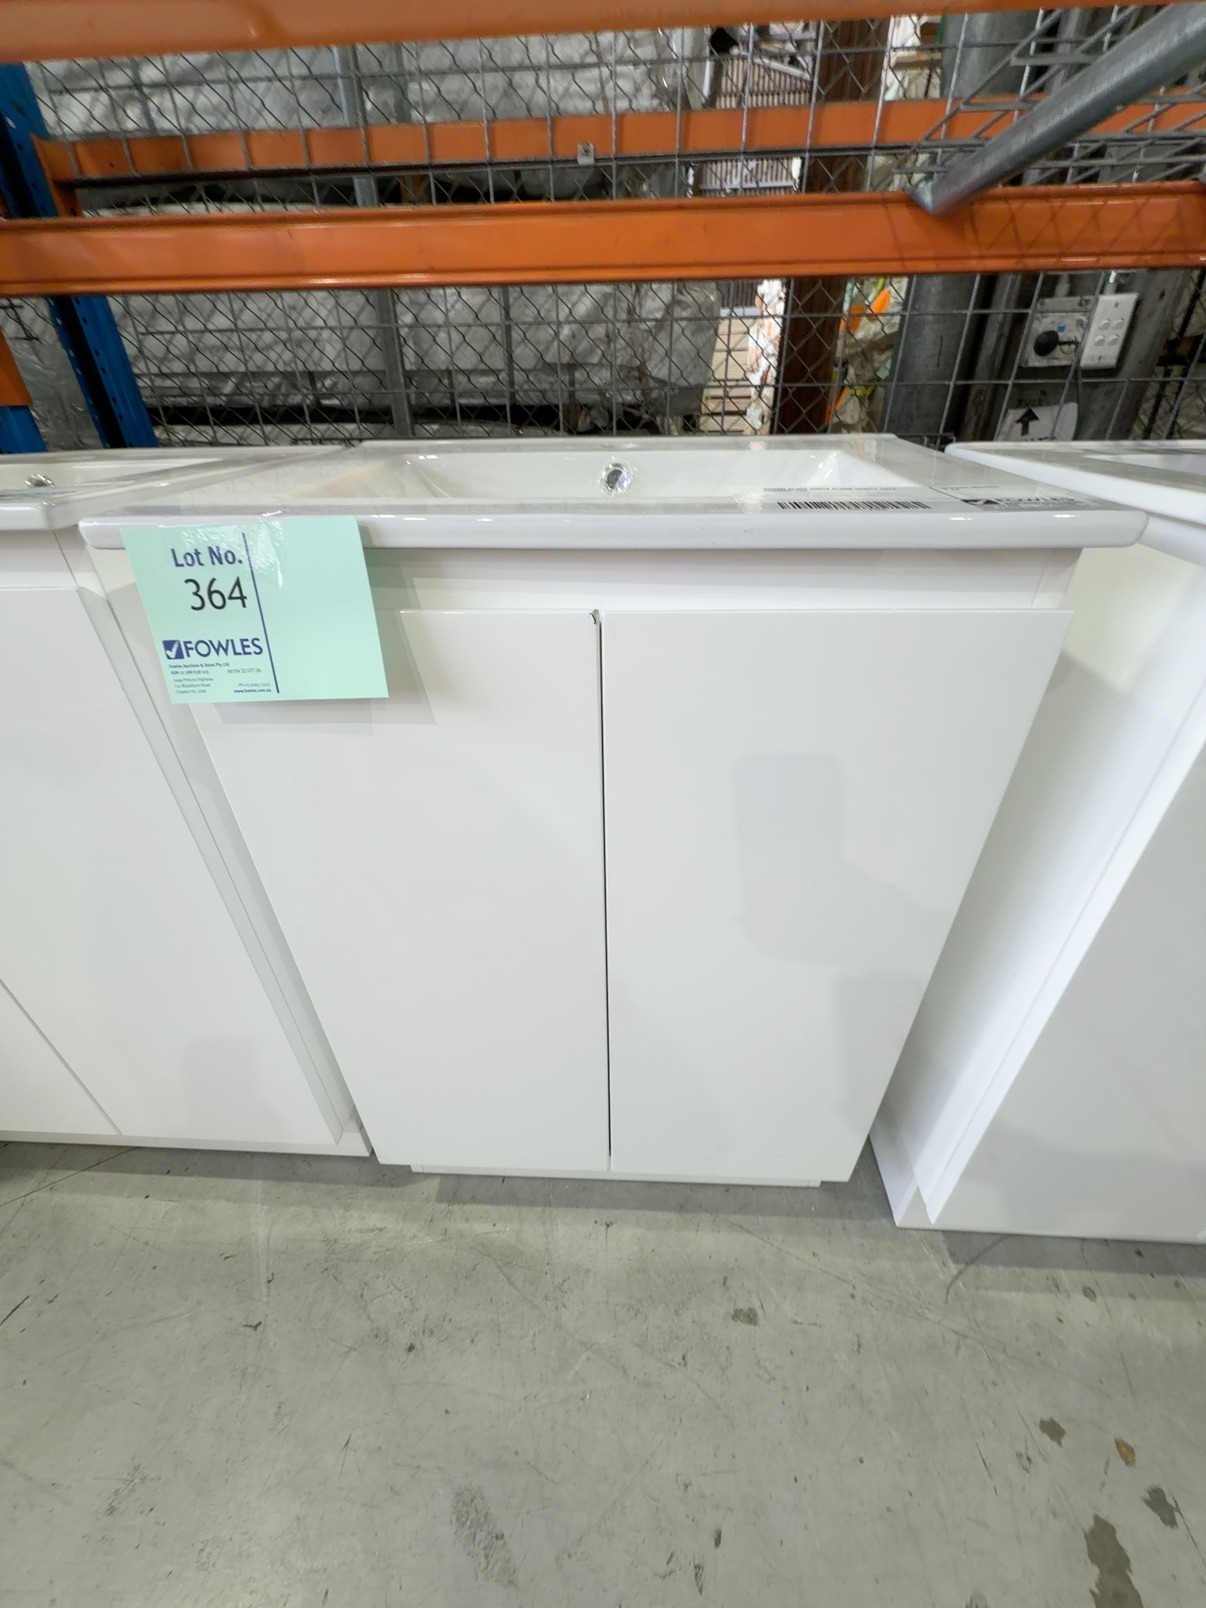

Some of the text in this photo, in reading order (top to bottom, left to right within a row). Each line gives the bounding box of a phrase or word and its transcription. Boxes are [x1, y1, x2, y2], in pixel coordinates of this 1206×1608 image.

[170, 546, 243, 567] Lot No.
[184, 576, 247, 611] 364
[183, 638, 263, 658] FOWLES
